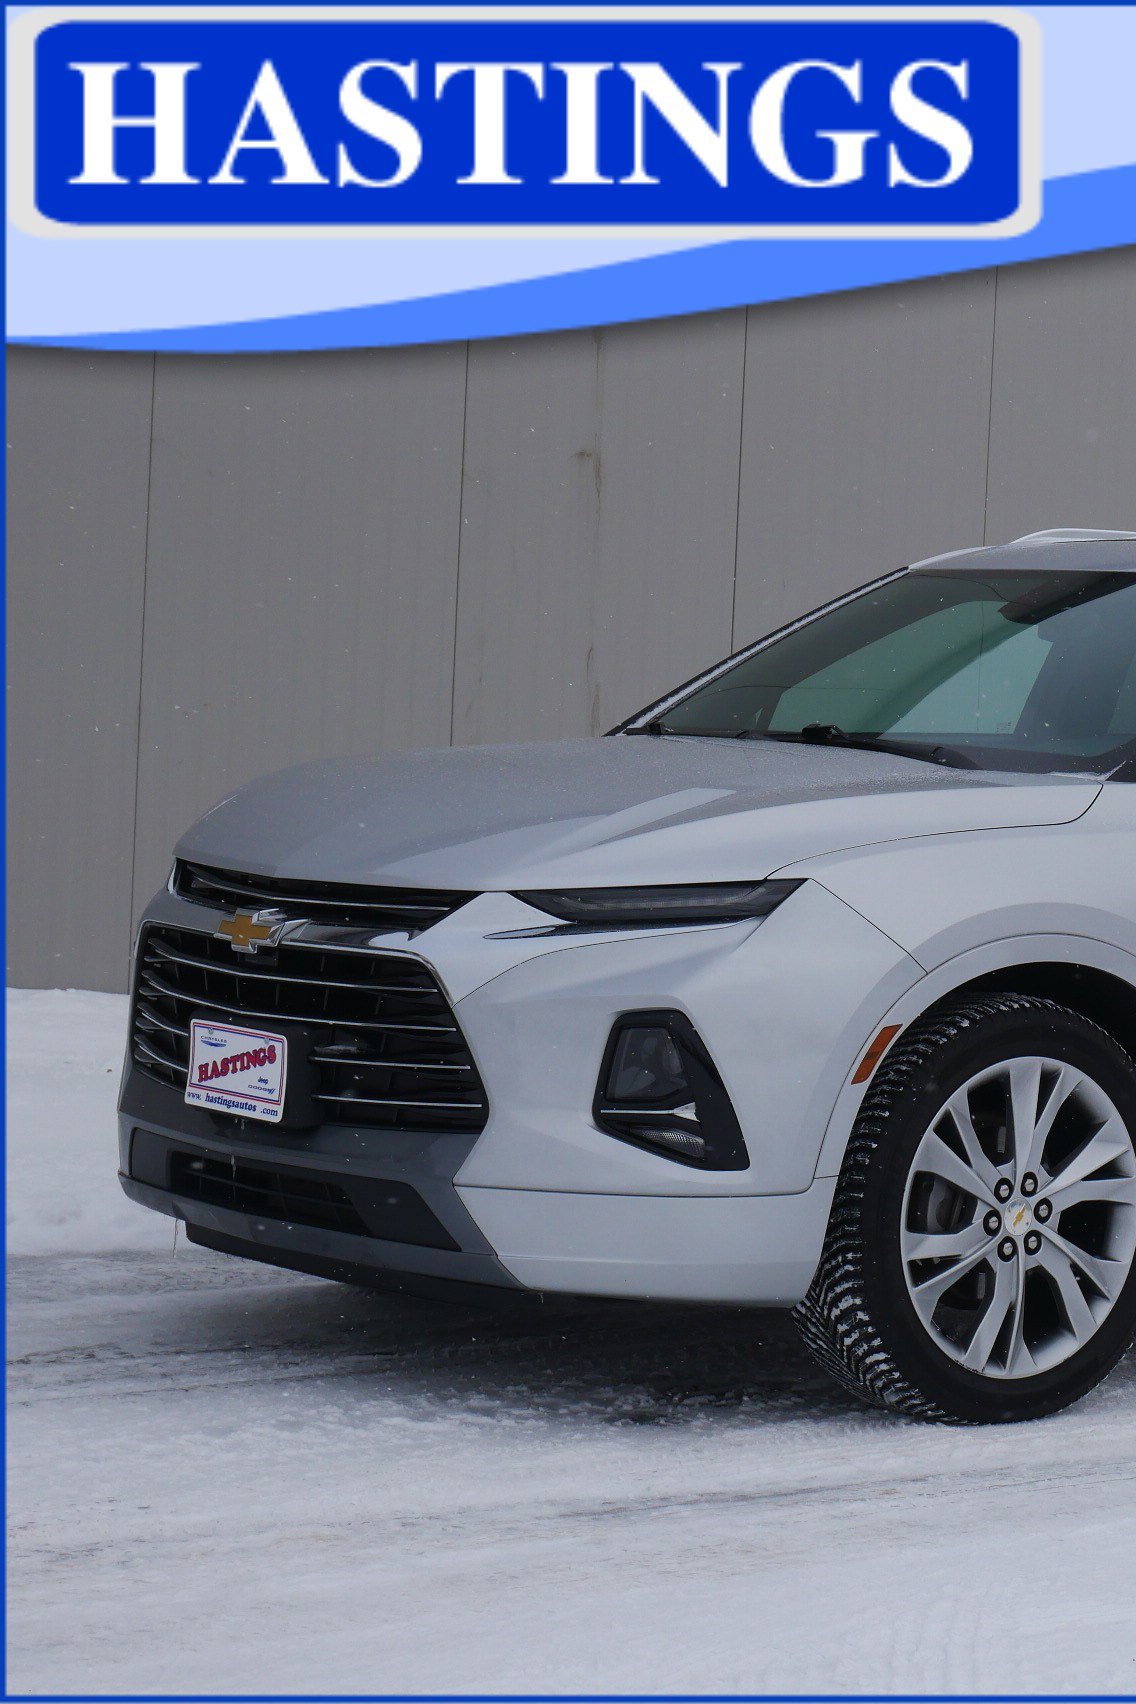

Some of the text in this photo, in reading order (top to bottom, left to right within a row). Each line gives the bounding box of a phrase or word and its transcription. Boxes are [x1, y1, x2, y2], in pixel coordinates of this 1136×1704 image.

[197, 1044, 277, 1084] HASTINGS
[204, 1093, 257, 1112] hastingsautos
[260, 1107, 279, 1117] .com
